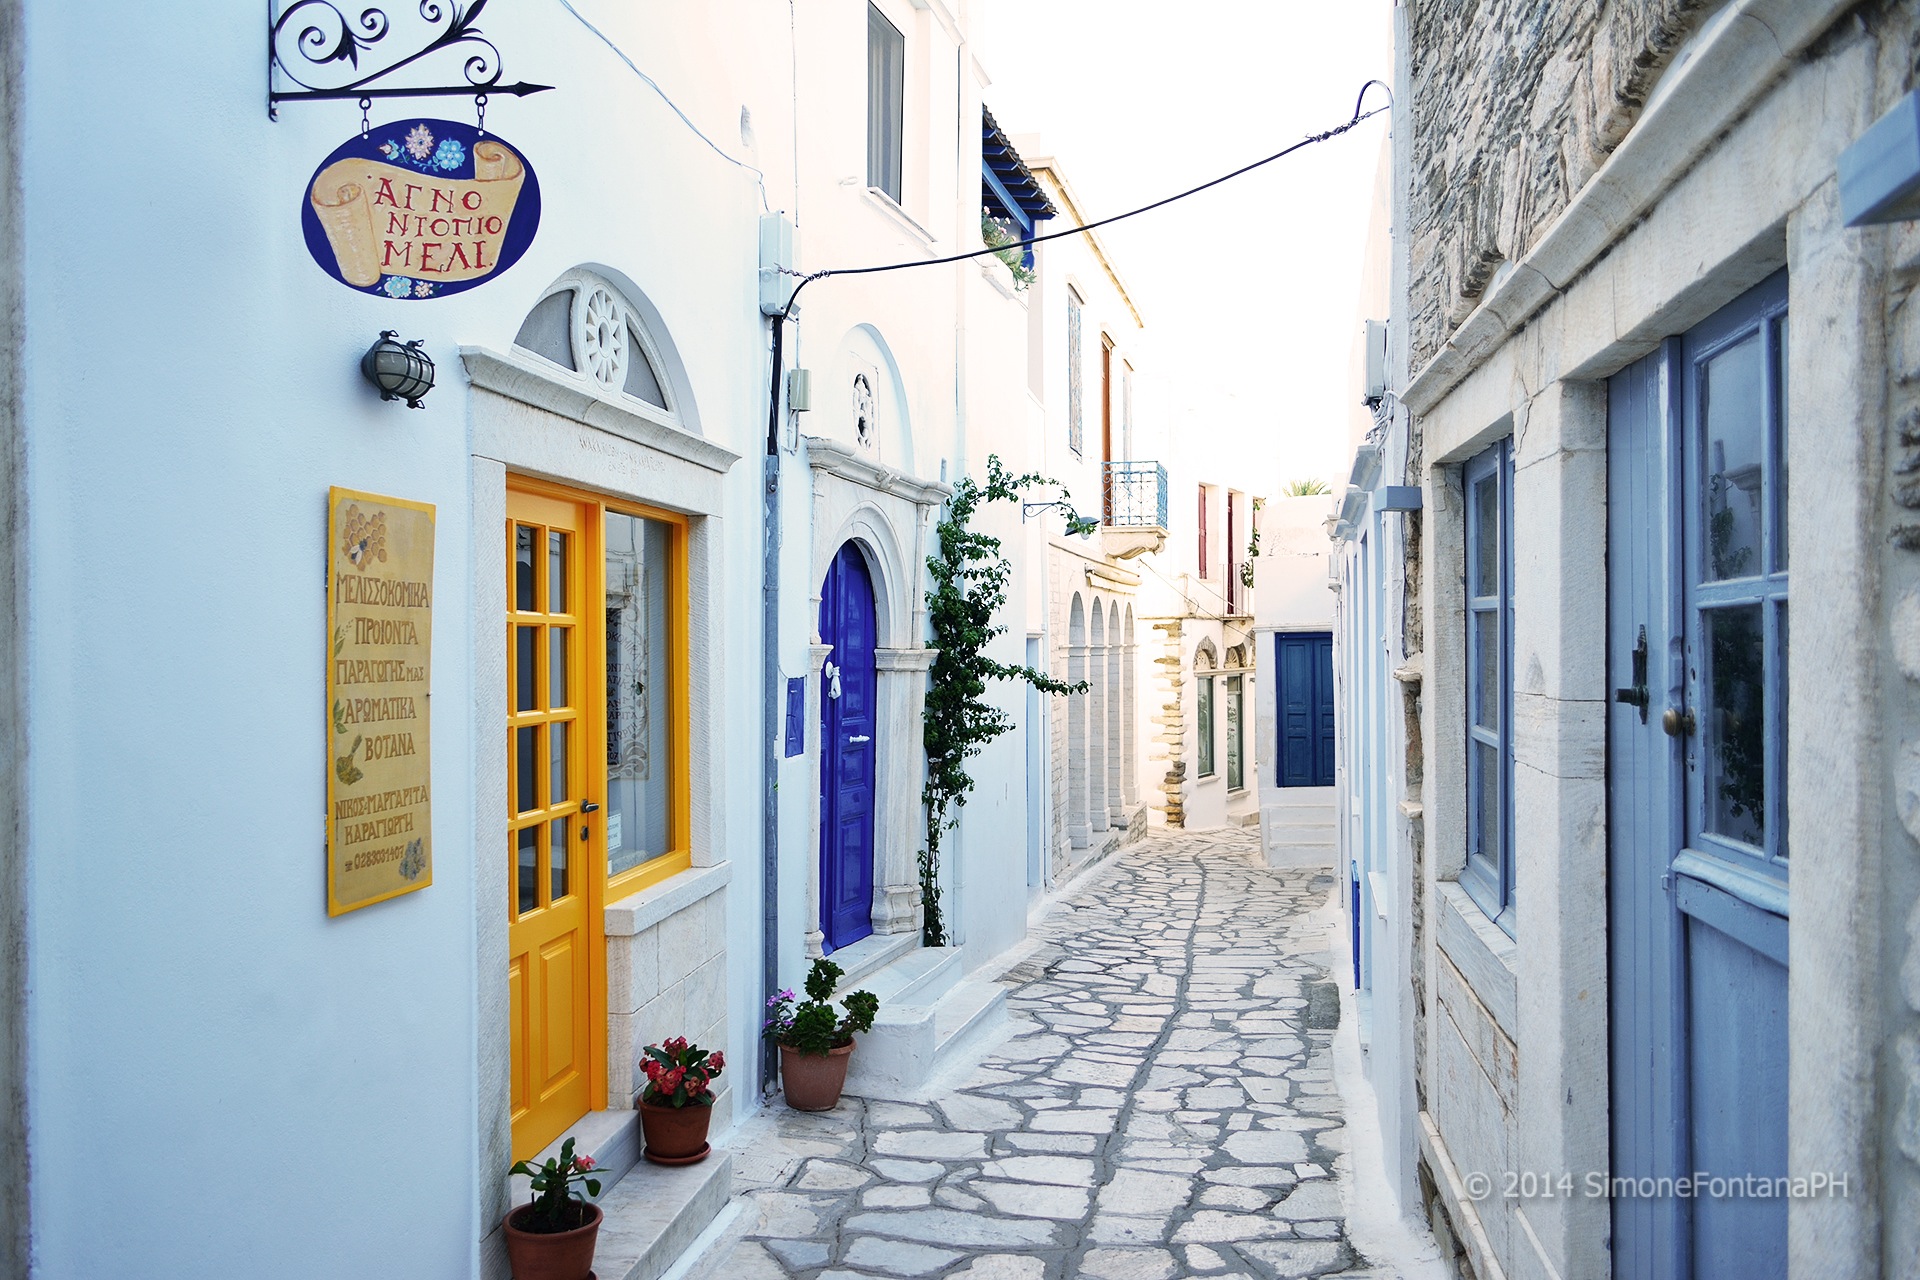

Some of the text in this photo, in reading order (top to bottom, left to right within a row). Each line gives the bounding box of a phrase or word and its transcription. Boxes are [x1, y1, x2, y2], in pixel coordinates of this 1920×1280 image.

[374, 177, 482, 213] ΑΓΝΟ
[386, 212, 503, 237] ΝΤΟΠΙΟ
[336, 573, 429, 608] ΜΕΛΙΣΣΟΚΟΜΙΚΑ
[355, 617, 418, 645] ΠΡΟΙΟΝΤΑ
[336, 660, 405, 685] ΠΑΡΑΓΩΓΗΣ
[343, 697, 417, 724] ΑΡΩΜΑΤΙΚΑ
[365, 733, 416, 761] ΒΟΤΑΝΑ
[344, 812, 414, 846] ΚΑΡΑΓΙΩΡΓΗ
